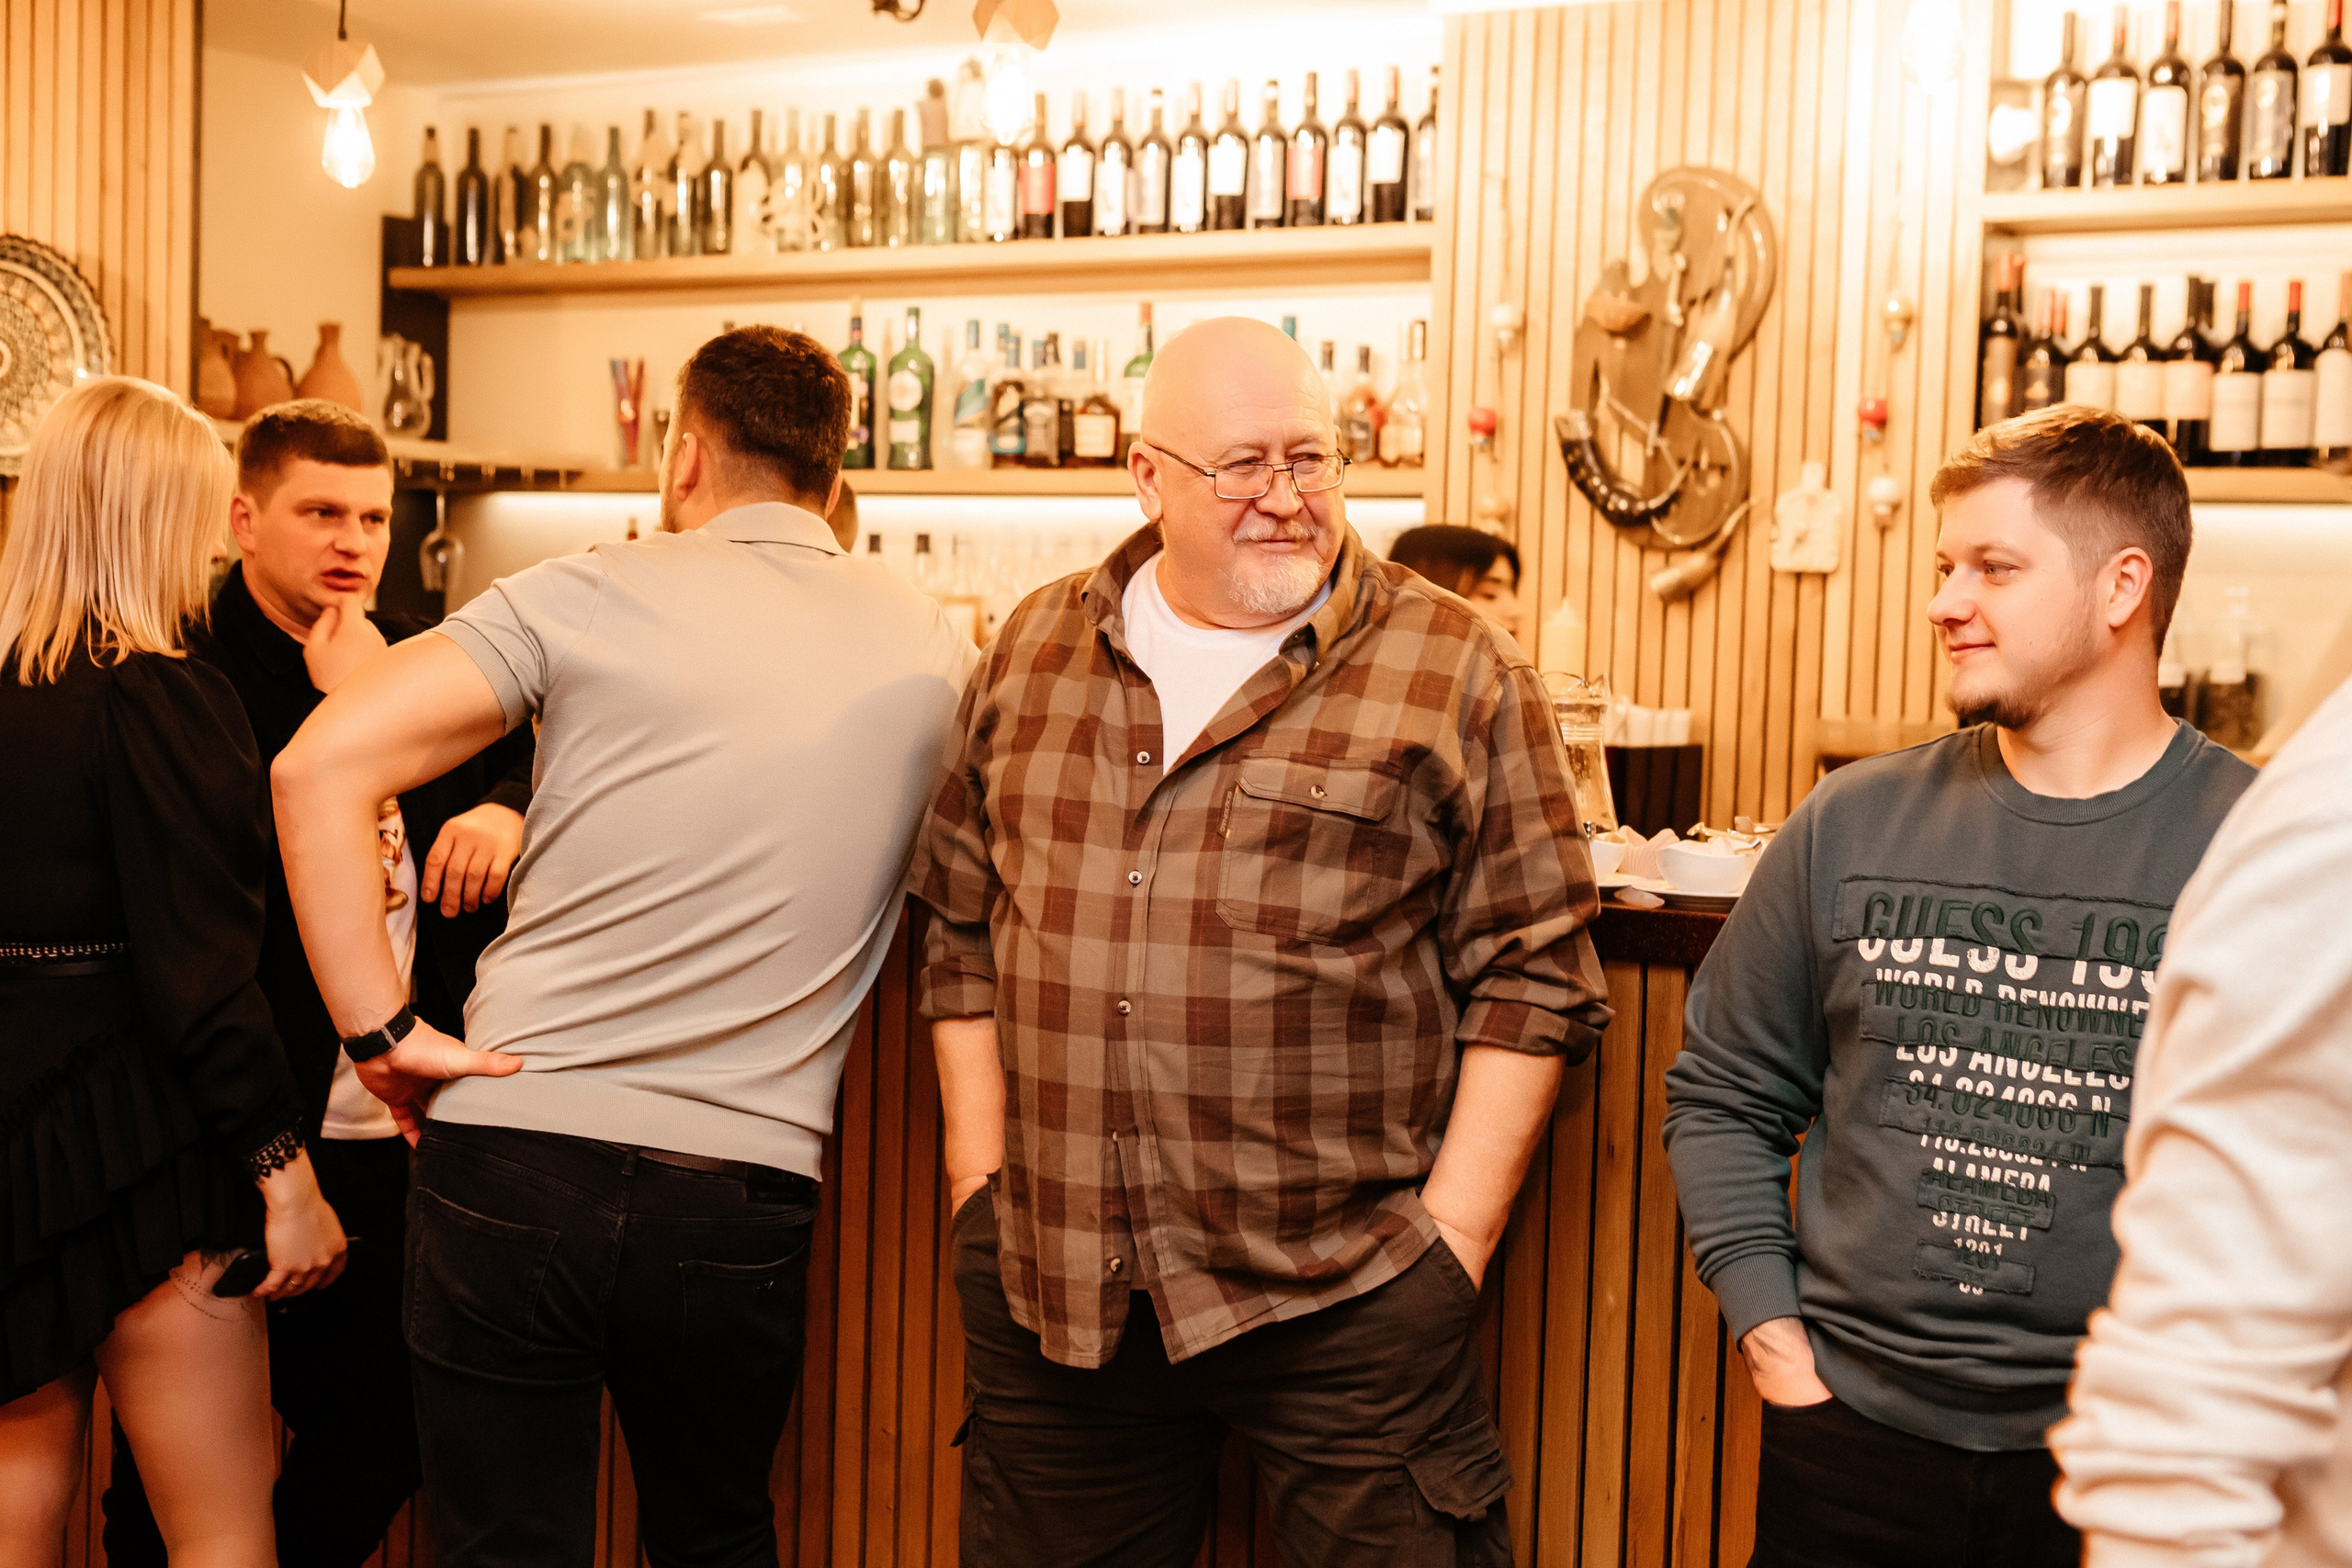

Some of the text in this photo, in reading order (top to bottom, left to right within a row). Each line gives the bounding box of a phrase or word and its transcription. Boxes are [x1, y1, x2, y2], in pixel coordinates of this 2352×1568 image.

[1858, 891, 2042, 981] GUESS
[1874, 968, 1984, 1017] WORLD
[1895, 1016, 2133, 1090] LOS ANGELES
[2091, 1094, 2112, 1139] N
[1929, 1156, 2052, 1209] ALAMEDA
[1932, 1195, 2035, 1241] STREET
